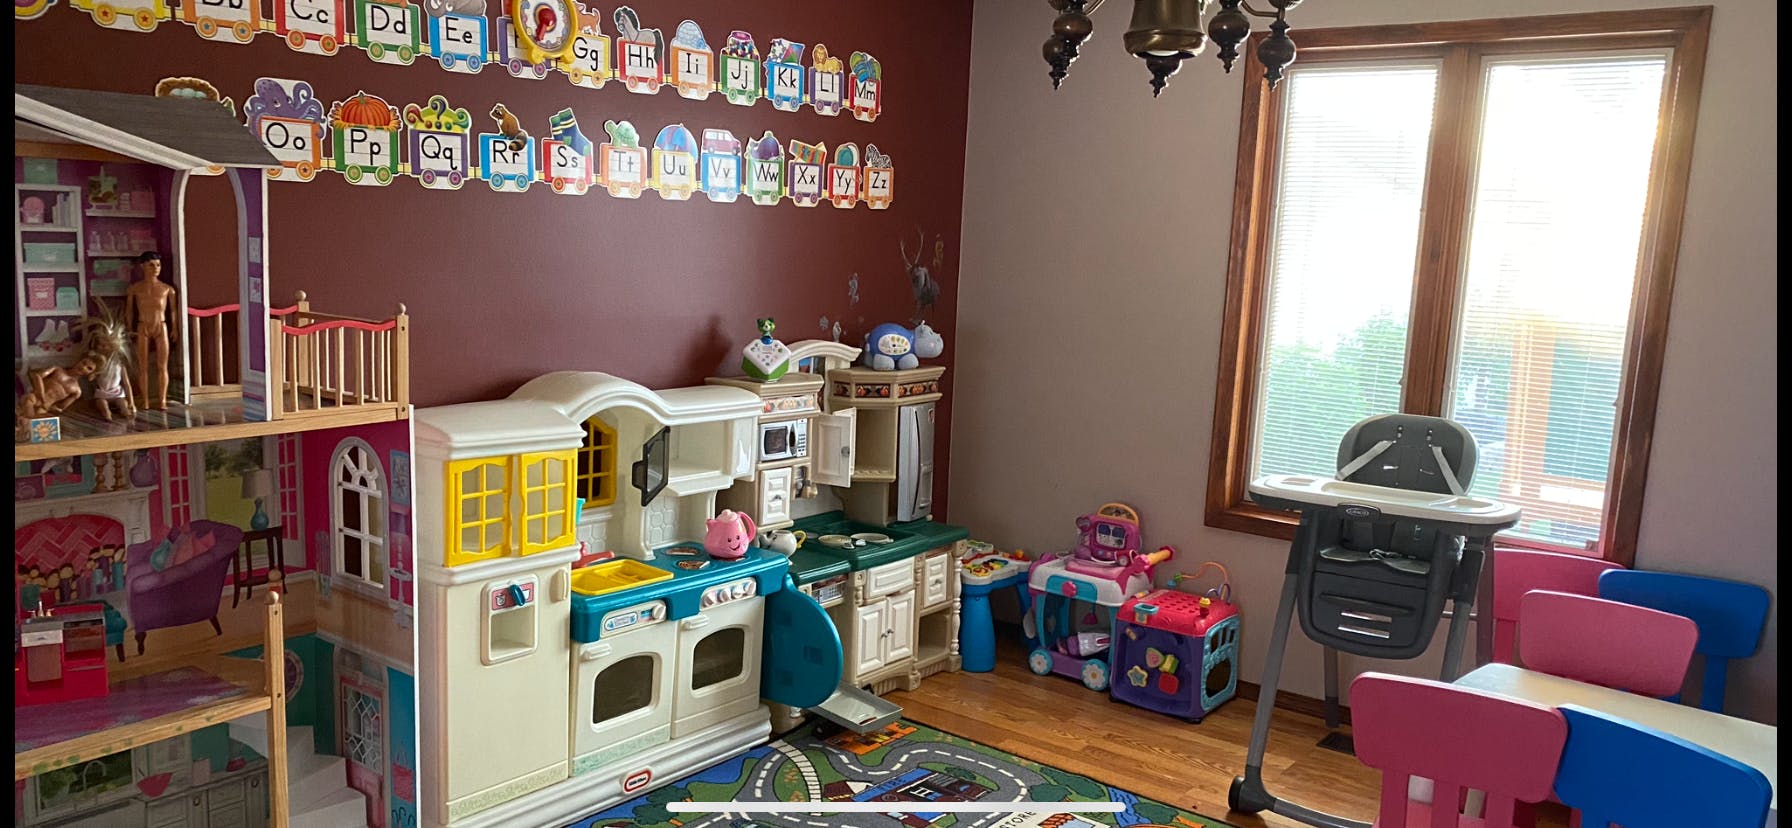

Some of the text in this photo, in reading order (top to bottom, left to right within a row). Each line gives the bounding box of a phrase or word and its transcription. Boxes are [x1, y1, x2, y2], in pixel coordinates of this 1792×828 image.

[291, 0, 876, 101] Cc Dd Ee Gg Hh Ii Jj Kk Ll Mm
[266, 122, 887, 194] Oo Pp Qq Rr Ss Tt Uu Vv Ww Xx Yy Zz
